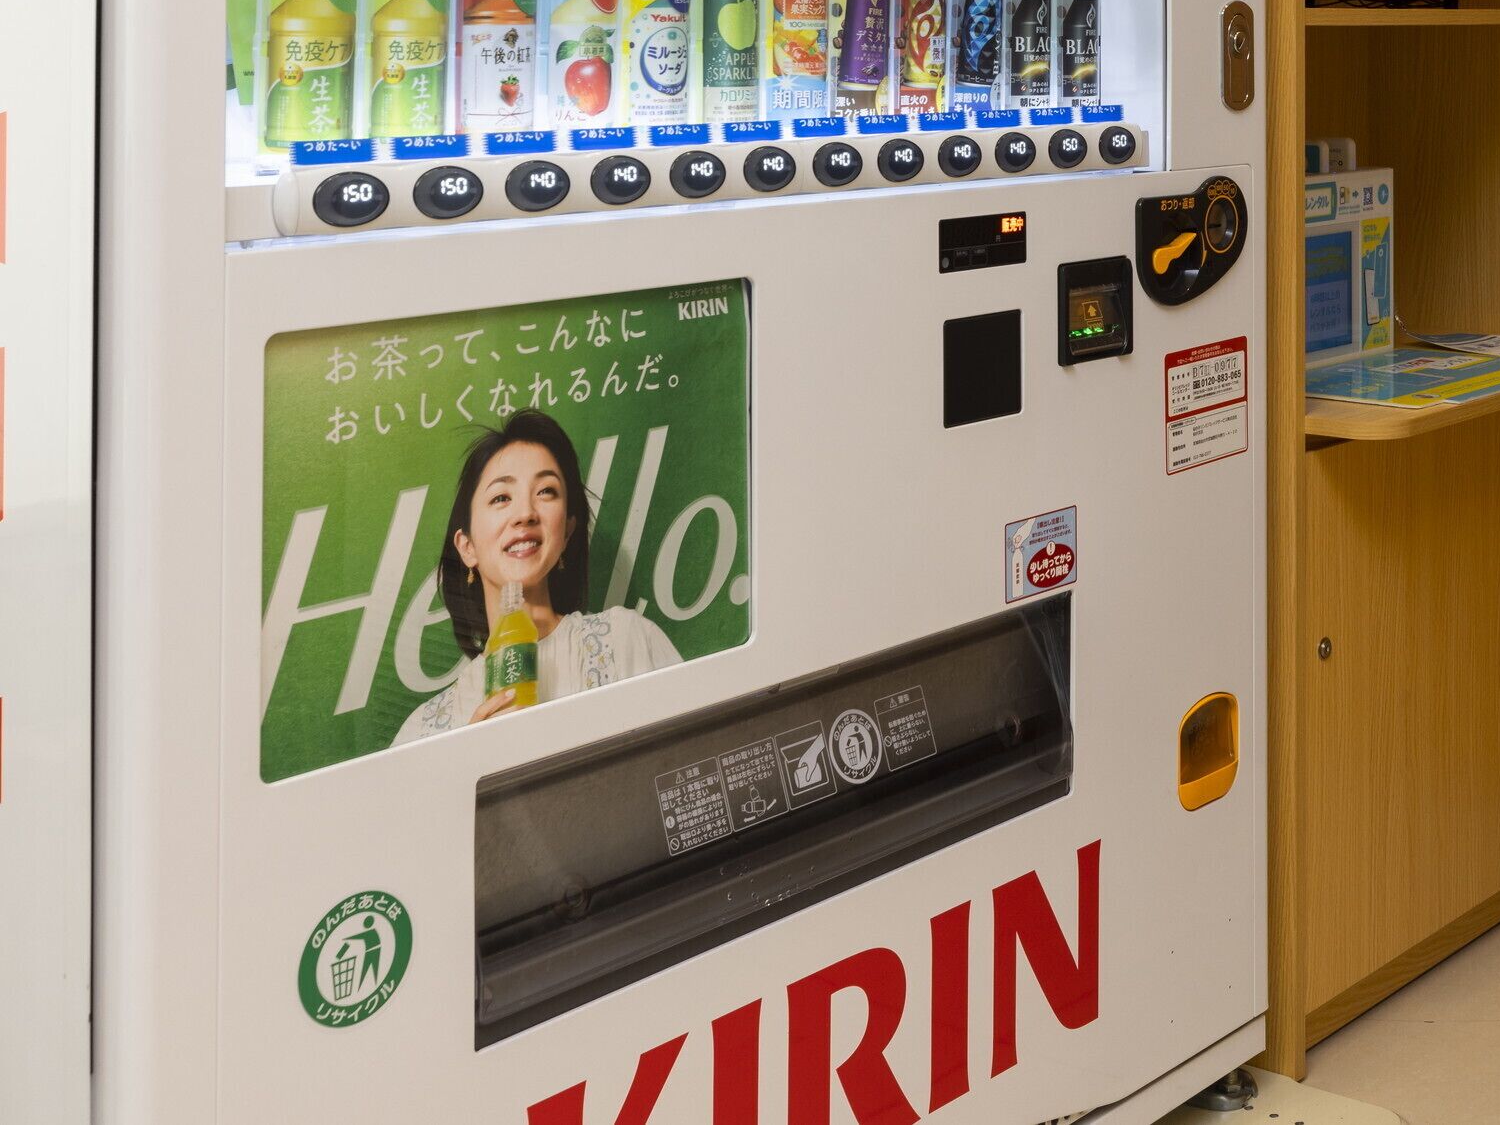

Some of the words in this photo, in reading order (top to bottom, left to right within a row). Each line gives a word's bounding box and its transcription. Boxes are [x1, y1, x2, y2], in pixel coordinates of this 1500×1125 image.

[650, 13, 687, 23] Yakult
[868, 8, 883, 16] FIRE
[1035, 26, 1048, 34] FIRE
[659, 63, 683, 75] ソーダ
[309, 75, 335, 134] 生茶
[410, 74, 433, 130] 生茶
[835, 96, 856, 106] 深い
[900, 95, 929, 106] 直火の
[954, 91, 989, 103] 深煎りの
[1009, 141, 1026, 155] 140
[1062, 137, 1078, 151] 150
[1112, 134, 1127, 148] 150
[831, 151, 851, 167] 140
[894, 148, 913, 163] 140
[954, 144, 971, 158] 140
[690, 160, 714, 177] 140
[763, 155, 784, 171] 140
[530, 171, 556, 188] 140
[613, 165, 637, 182] 140
[343, 183, 373, 202] 150
[440, 177, 468, 196] 150
[1001, 216, 1024, 233] 販売中
[678, 297, 729, 321] KIRIN
[326, 307, 647, 384] お茶って、こんなに
[326, 353, 680, 444] おいしくなれるんだ。
[1030, 552, 1072, 574] 少し待ってから
[1032, 565, 1069, 584] ゆっくり開栓
[503, 648, 521, 684] 生茶
[833, 714, 872, 742] のんだあとは
[722, 742, 772, 767] 商品の取り出し方
[725, 753, 774, 775] たてになって出てきた
[685, 767, 701, 779] 注意
[726, 761, 776, 783] 商品は左右にずらして
[843, 755, 877, 778] リサイクル
[728, 771, 772, 791] 取り出してください
[661, 789, 709, 811] 出してください
[682, 826, 729, 849] 入れないでください
[312, 893, 402, 949] のんだあとは
[316, 979, 395, 1025] リサイクル
